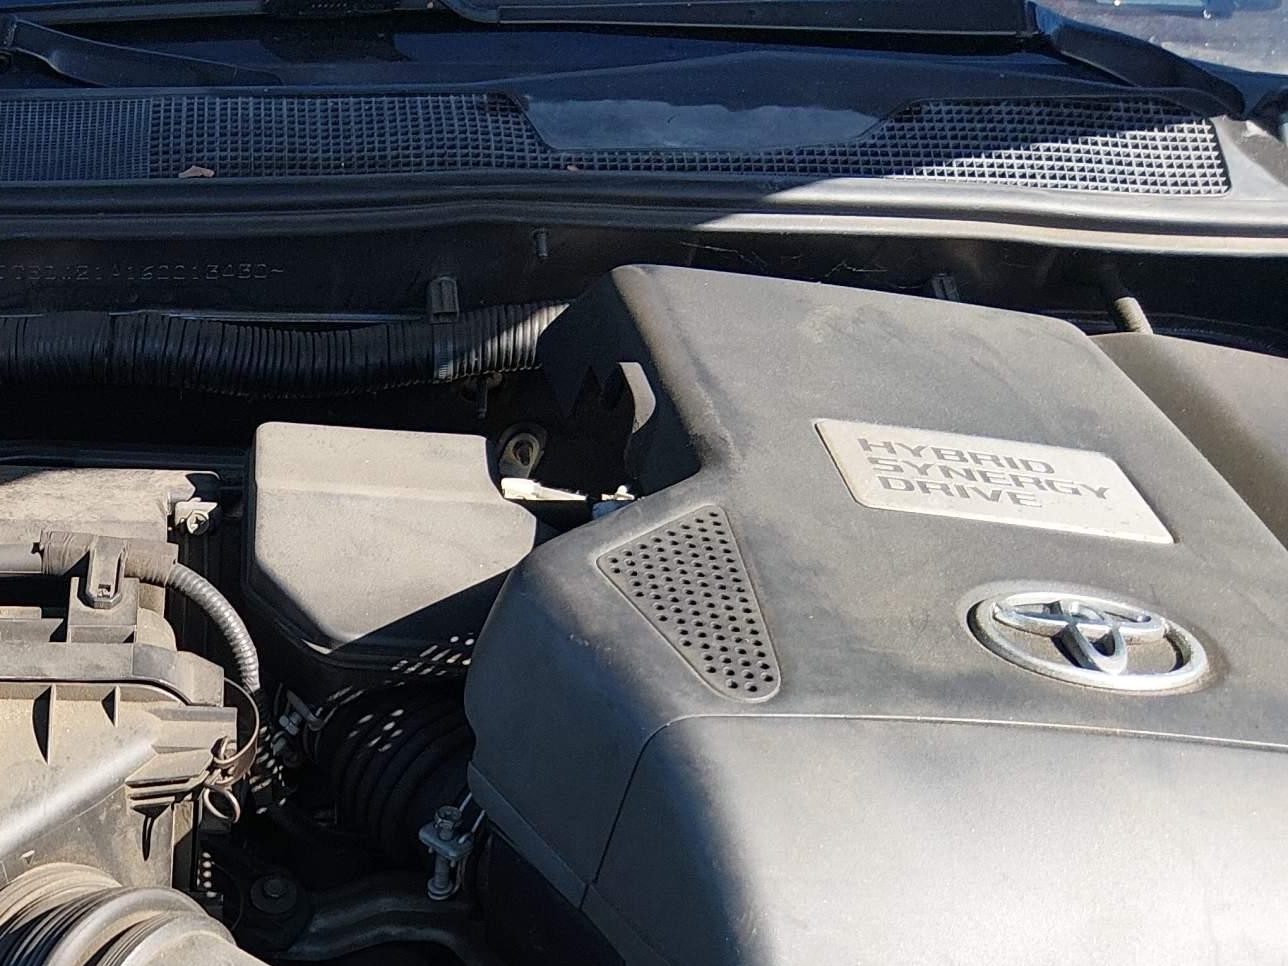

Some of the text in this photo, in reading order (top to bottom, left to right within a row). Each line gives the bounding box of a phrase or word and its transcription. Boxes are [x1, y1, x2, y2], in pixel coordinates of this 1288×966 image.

[856, 437, 1056, 475] HYBRID
[866, 456, 1111, 500] SYNERGY
[876, 475, 1044, 509] DRIVE
